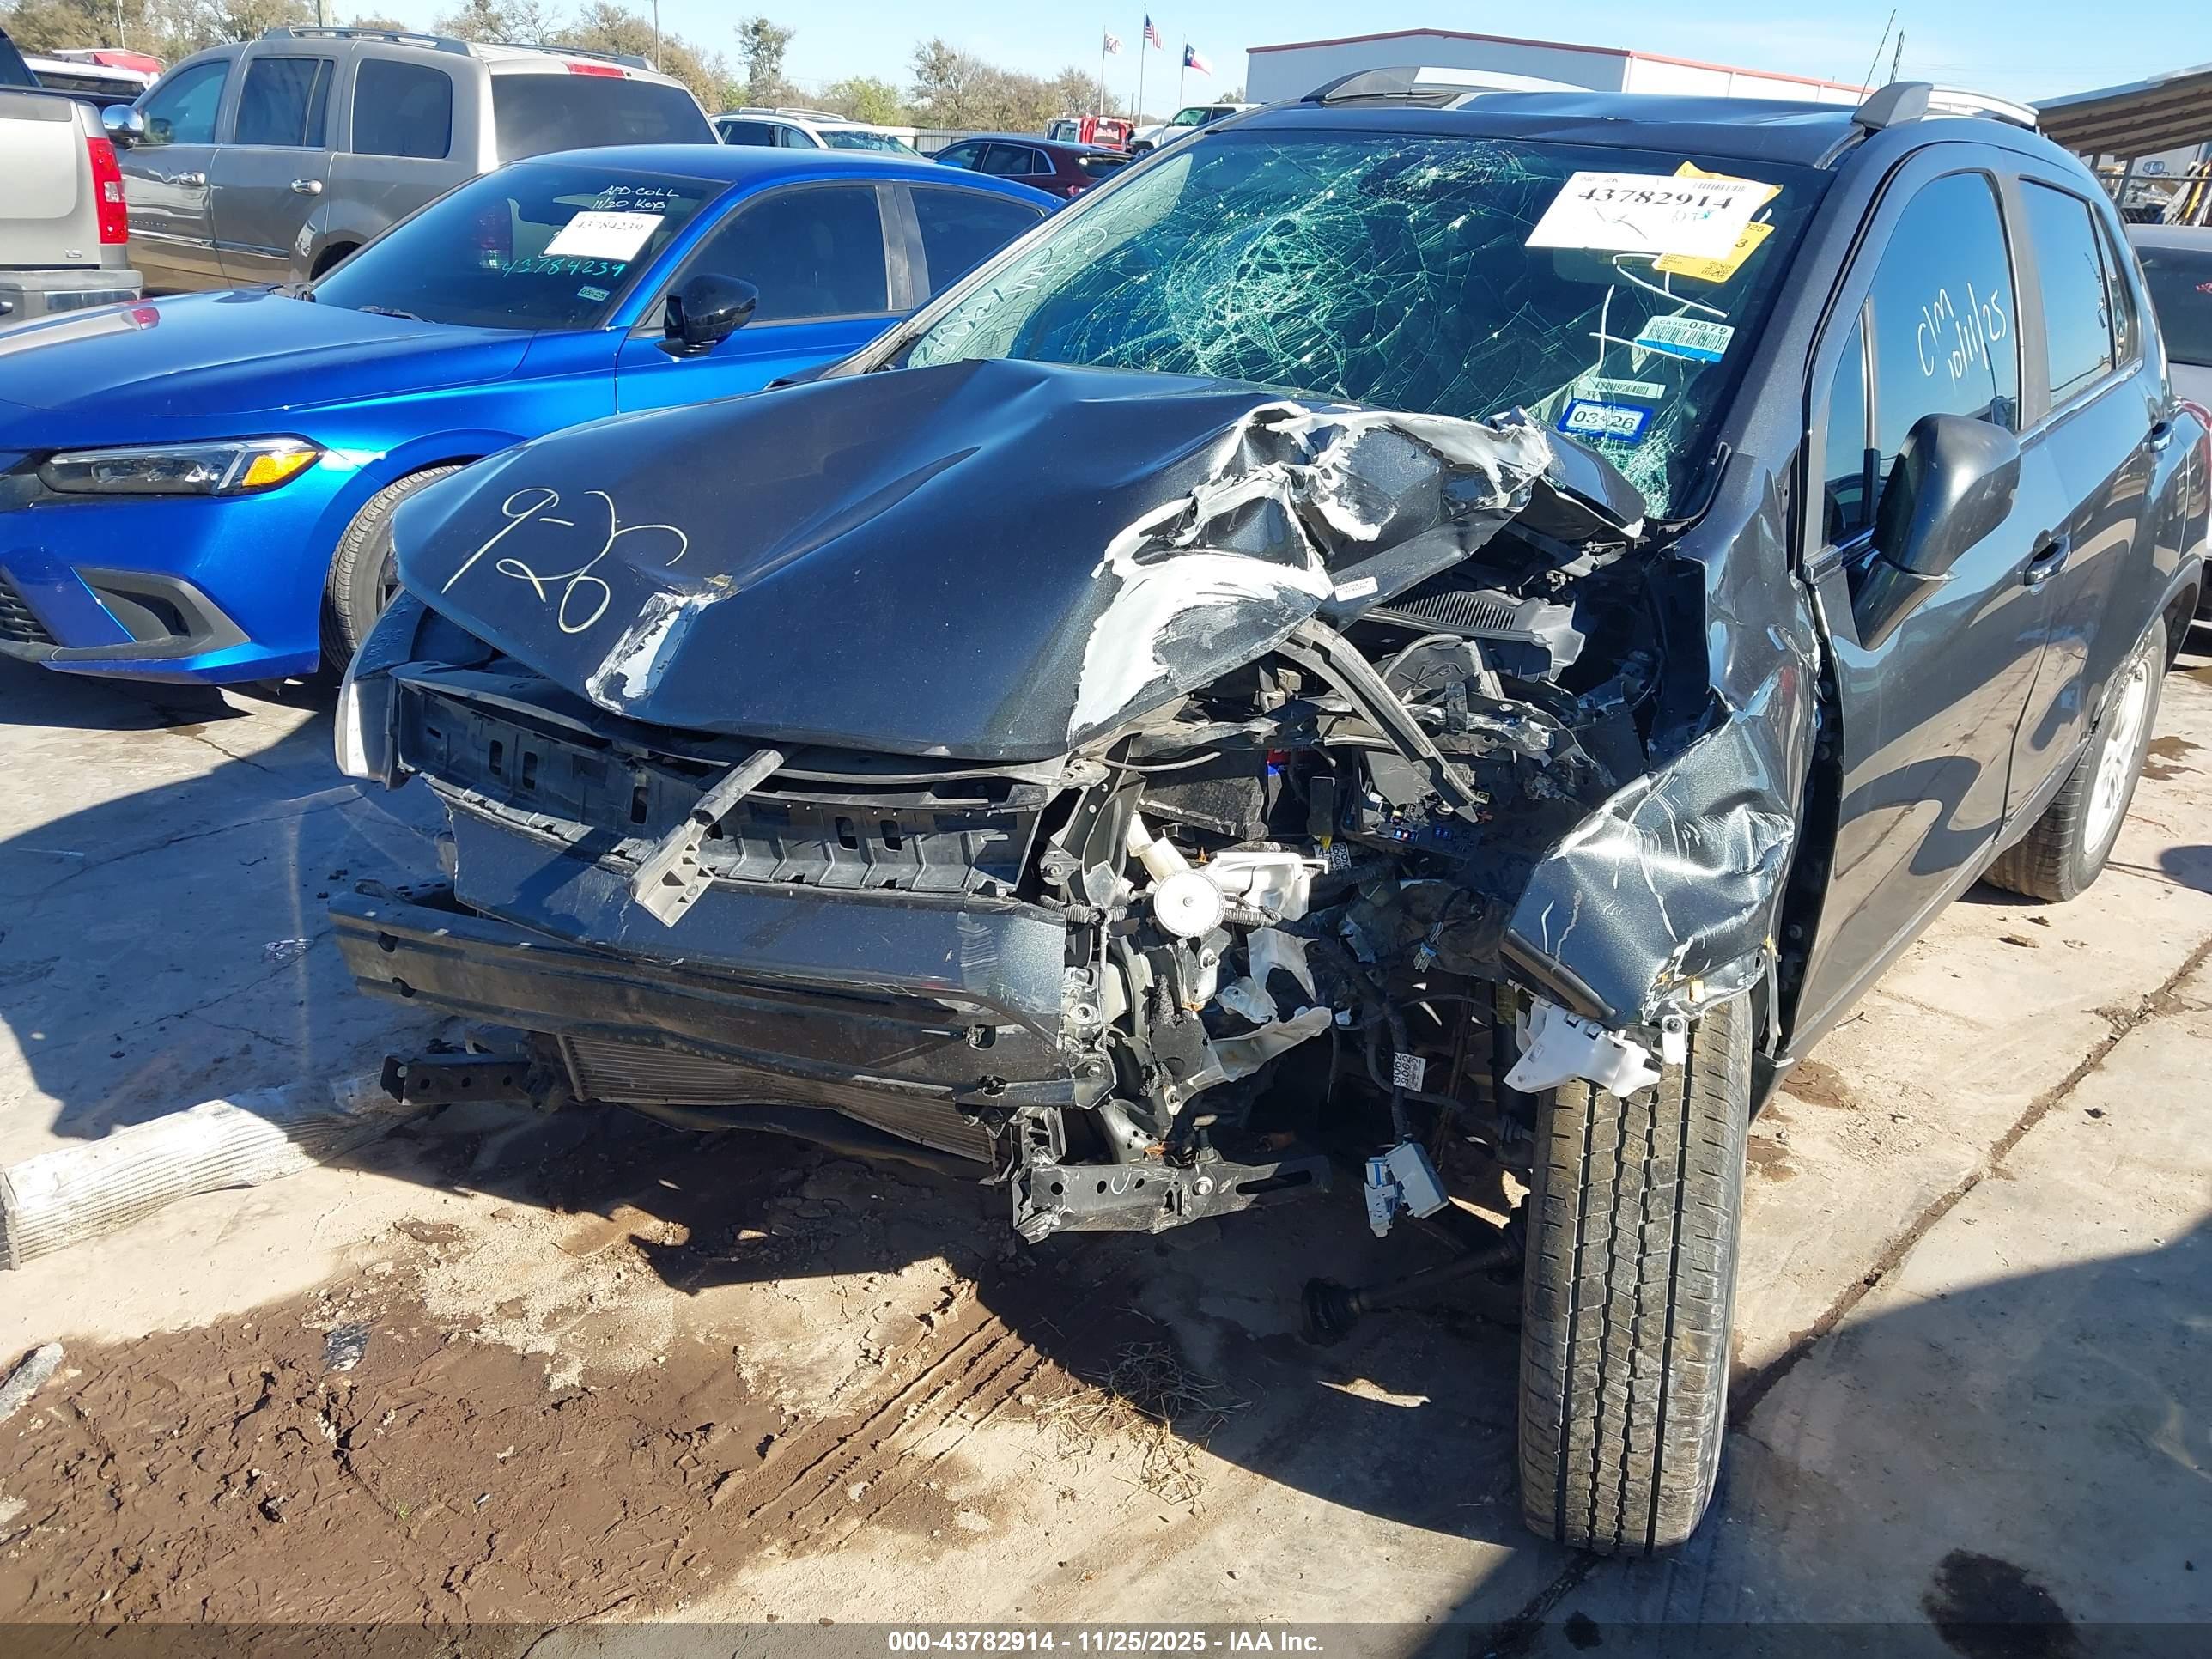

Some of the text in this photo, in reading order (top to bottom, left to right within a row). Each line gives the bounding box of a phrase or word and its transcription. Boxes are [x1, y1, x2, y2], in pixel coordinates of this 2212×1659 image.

[634, 198, 665, 210] Keys
[1578, 187, 1733, 209] 43782914
[502, 259, 627, 277] 43784239
